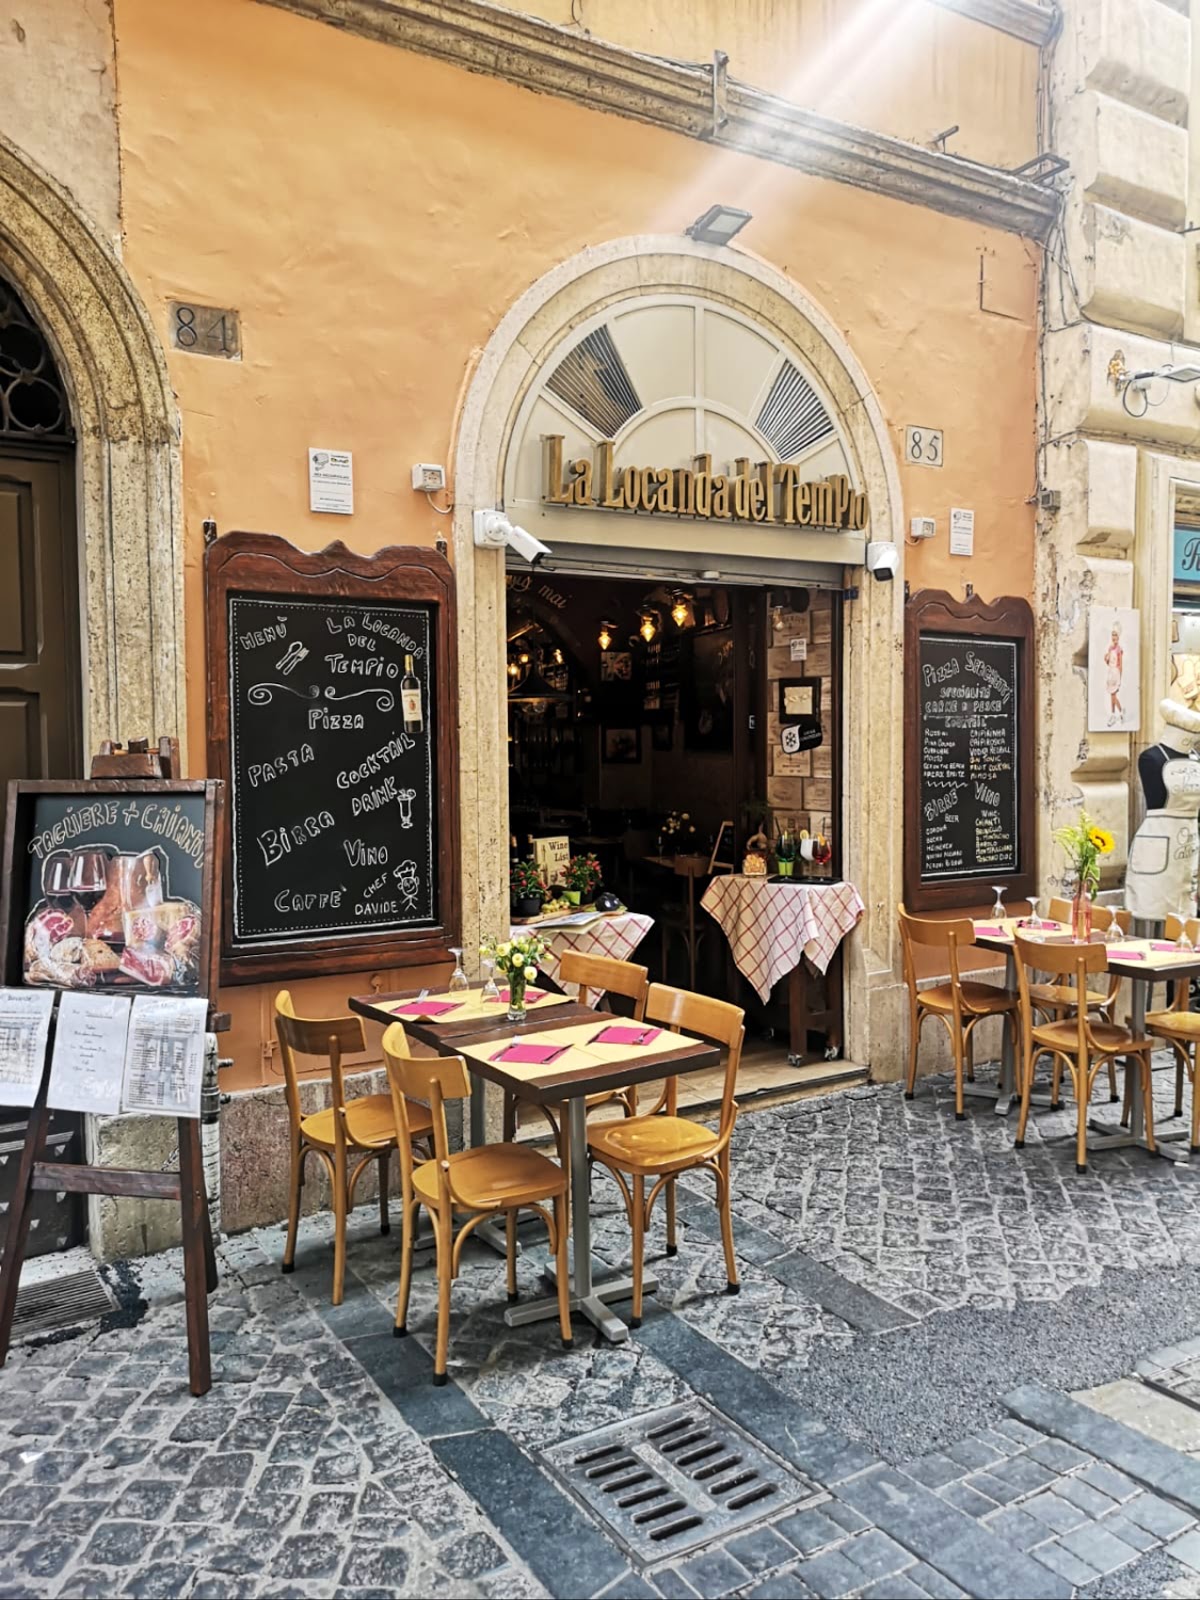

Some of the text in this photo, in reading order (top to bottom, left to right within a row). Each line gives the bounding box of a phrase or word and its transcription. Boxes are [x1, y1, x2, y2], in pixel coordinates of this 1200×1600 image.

[177, 307, 230, 352] 84
[911, 431, 939, 461] 85
[542, 434, 593, 505] La
[594, 440, 731, 518] Locanda
[735, 457, 774, 523] del
[326, 613, 424, 659] LA LOCANDA
[348, 634, 376, 651] DEL
[248, 744, 314, 787] PASTA
[336, 732, 416, 789] COCKTAIL
[28, 801, 120, 858] TAGLIERE
[945, 813, 959, 822] BEER
[548, 841, 569, 862] Wine List
[363, 873, 388, 898] CHEF
[354, 901, 398, 915] DAVIDE
